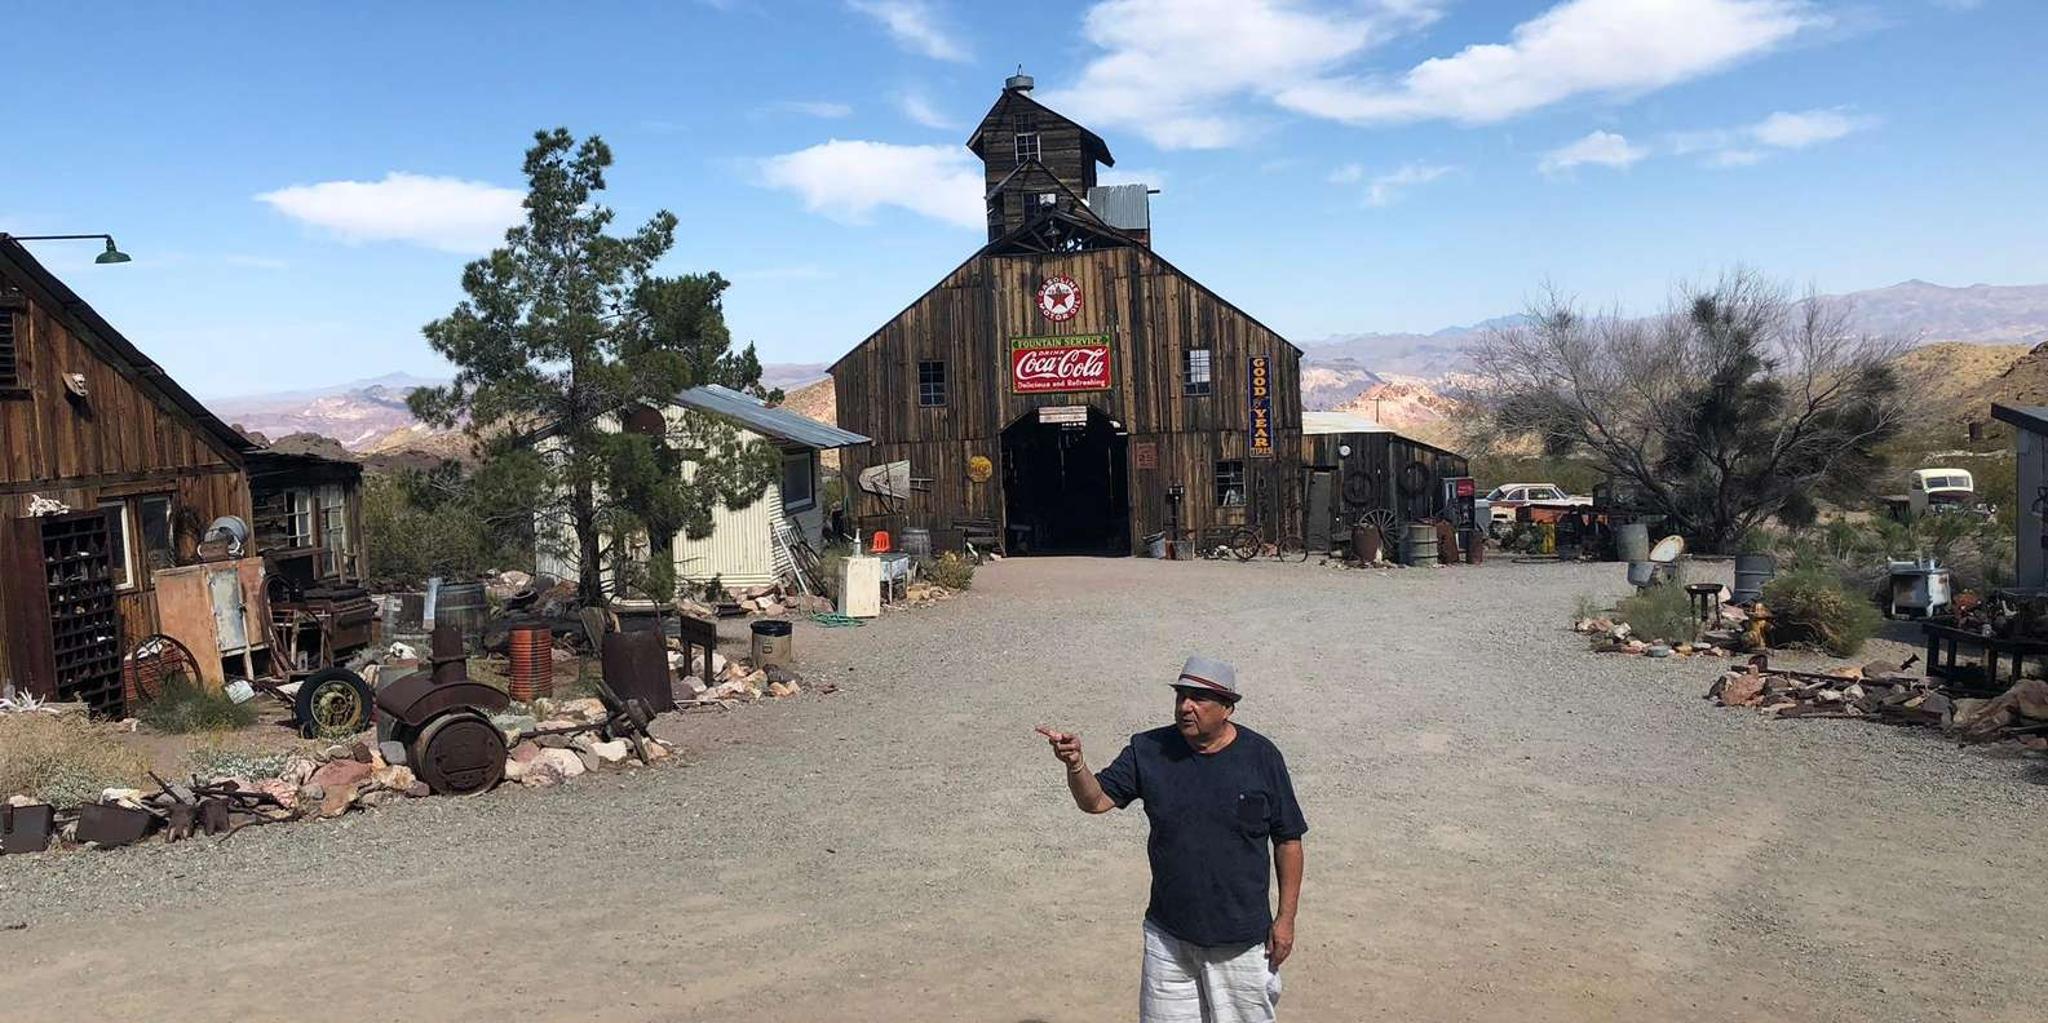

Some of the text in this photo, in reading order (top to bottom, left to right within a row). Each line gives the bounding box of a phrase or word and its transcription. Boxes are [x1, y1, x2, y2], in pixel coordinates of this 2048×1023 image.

[1019, 335, 1101, 349] FOUNTAIN SERVICE
[1052, 379, 1065, 387] and
[1067, 379, 1105, 388] Refreshing
